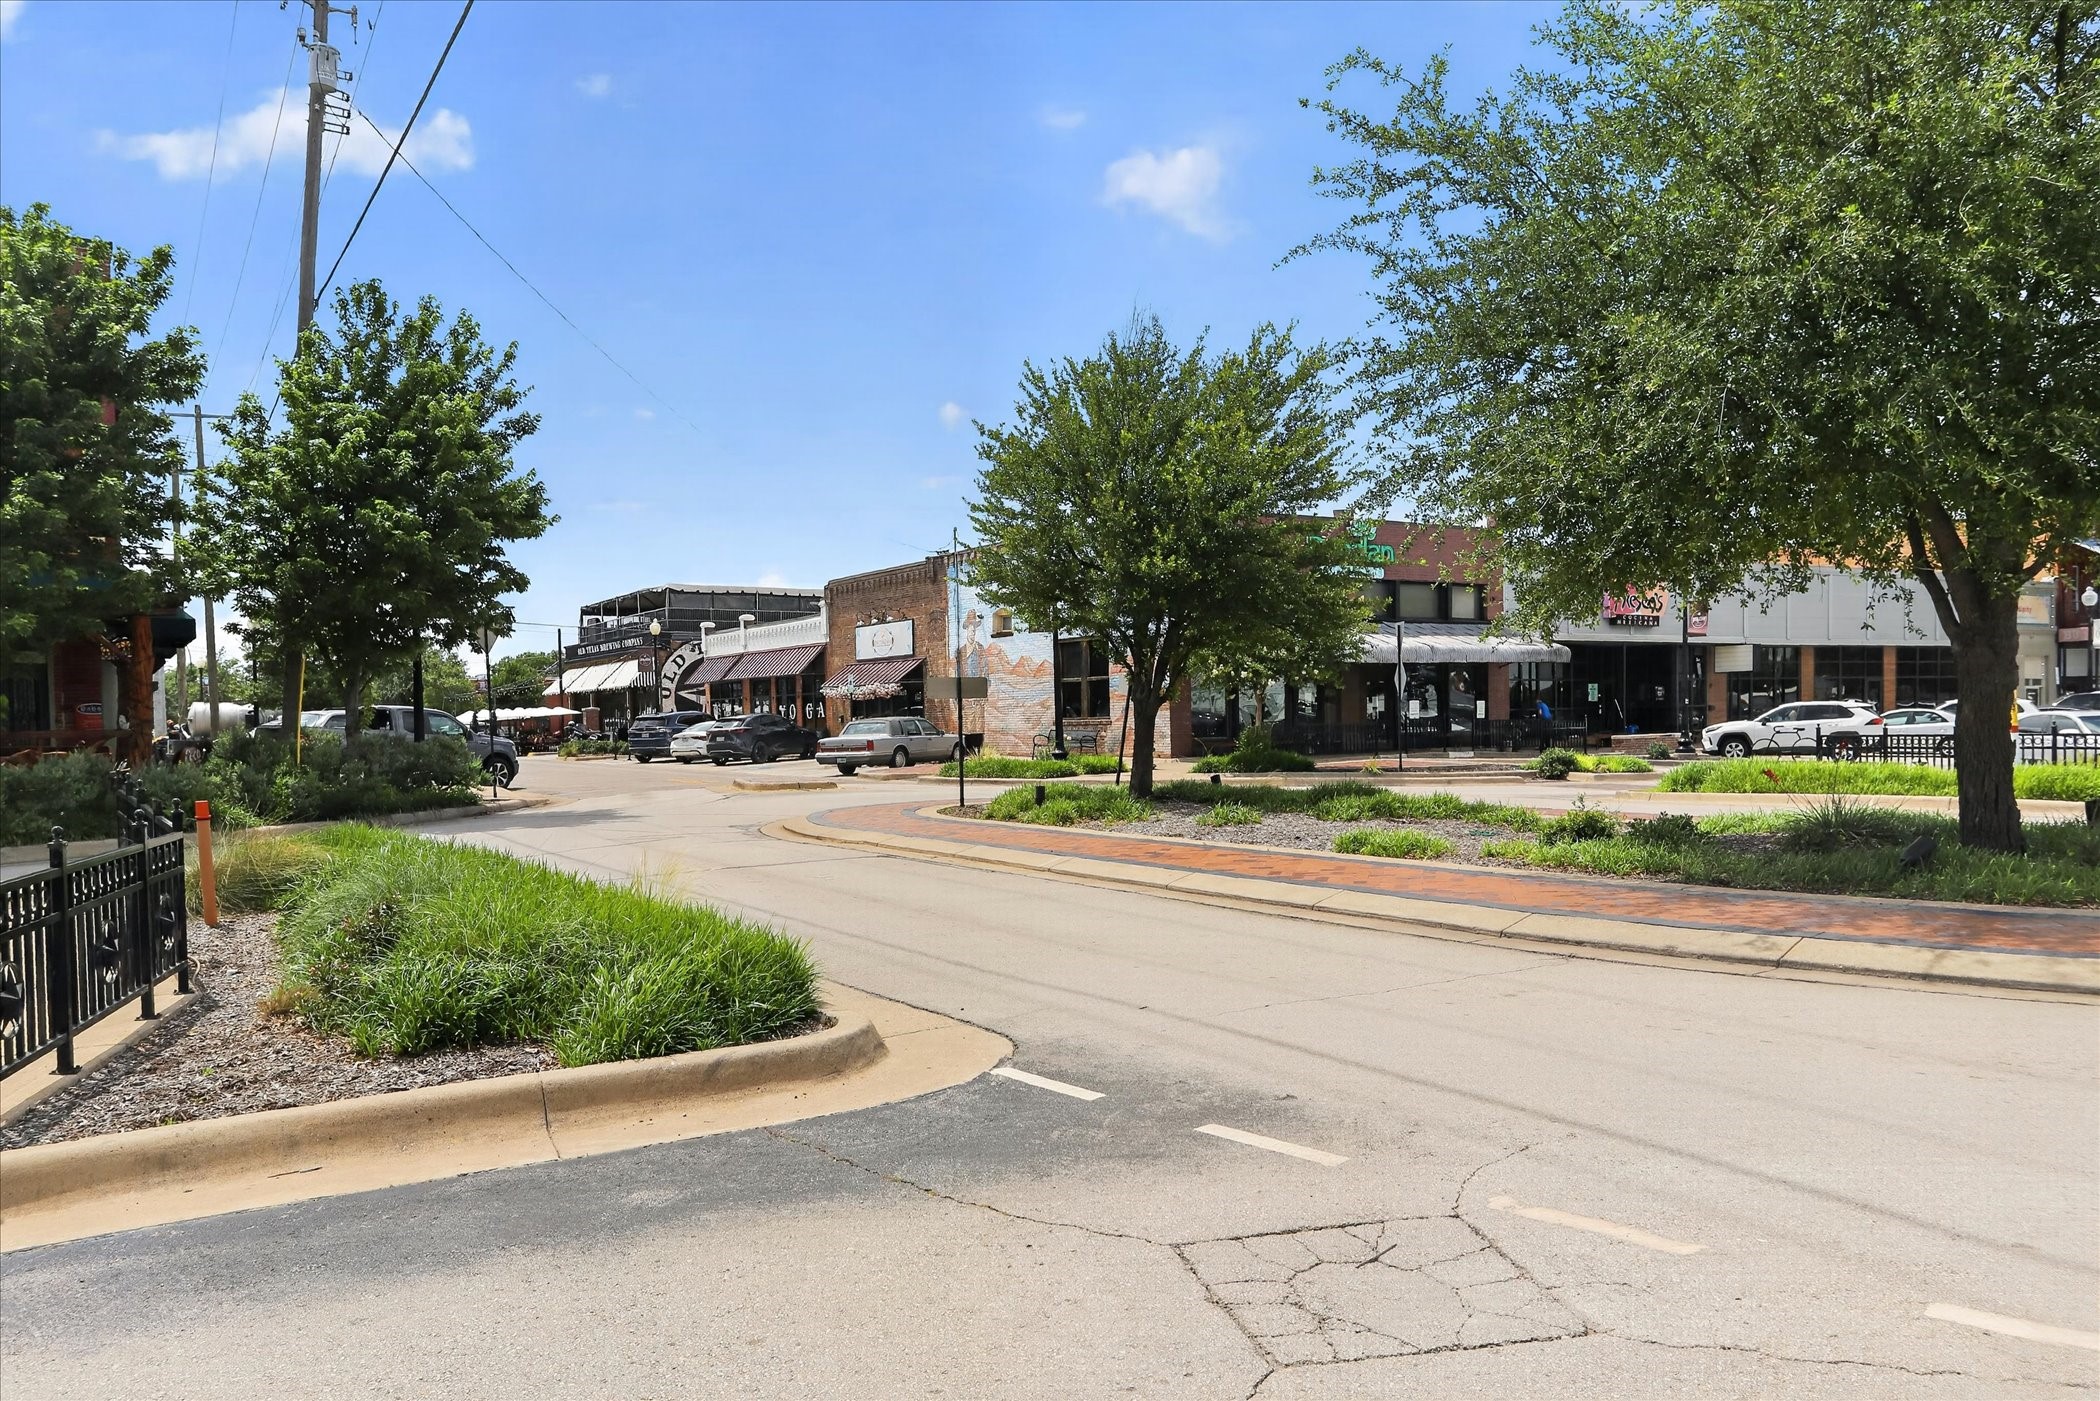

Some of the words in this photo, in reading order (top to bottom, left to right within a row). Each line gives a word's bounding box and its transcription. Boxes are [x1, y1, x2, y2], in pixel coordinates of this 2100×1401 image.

[577, 647, 586, 655] OLD
[586, 645, 600, 654] TEXAS
[600, 641, 621, 652] BREWING
[621, 637, 643, 648] COMPANY
[662, 654, 686, 699] OLD
